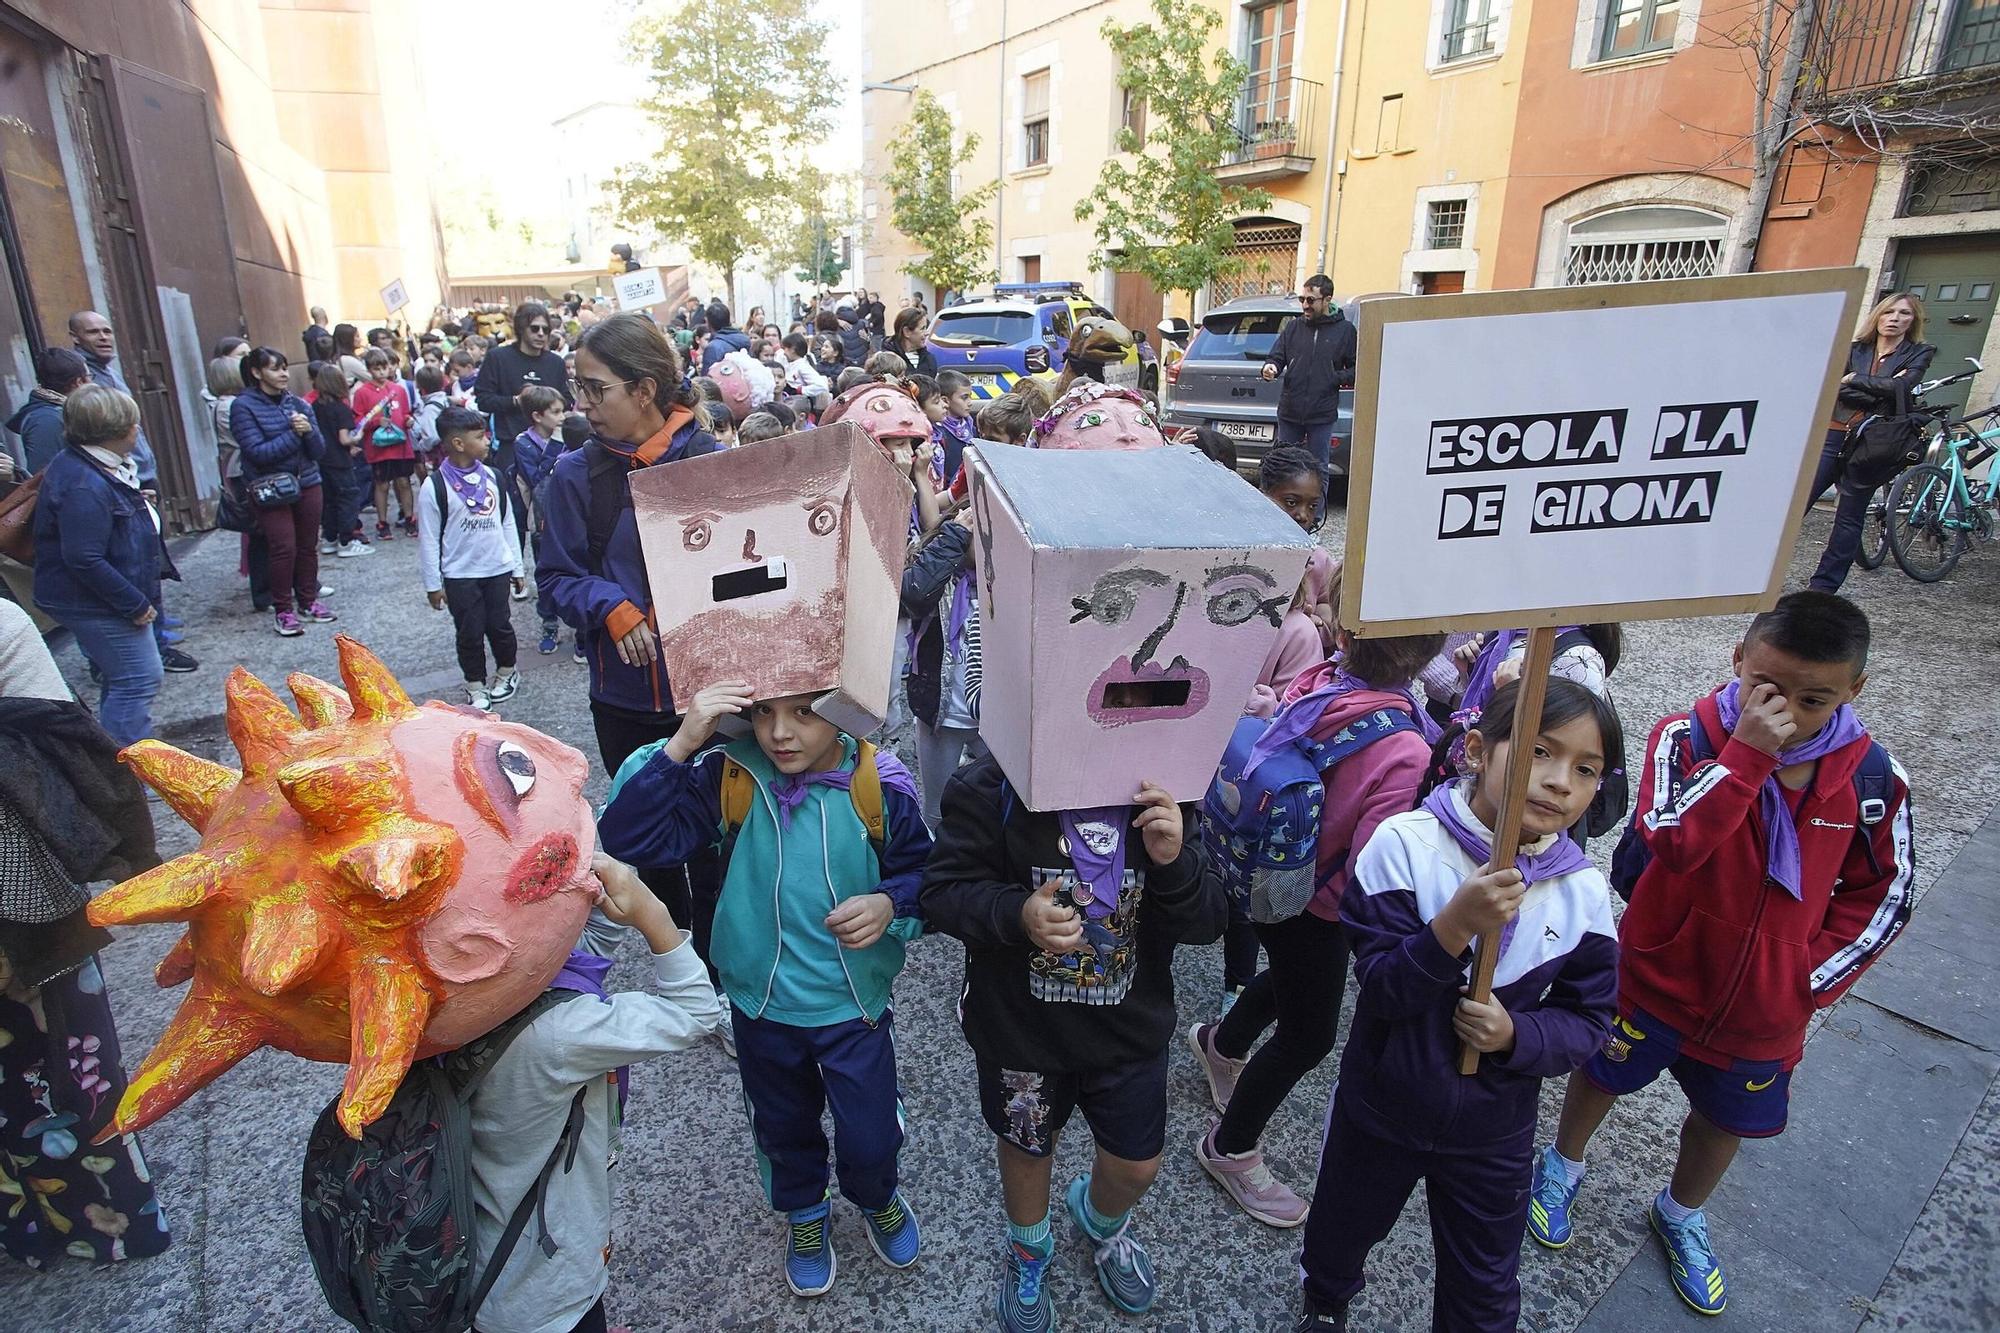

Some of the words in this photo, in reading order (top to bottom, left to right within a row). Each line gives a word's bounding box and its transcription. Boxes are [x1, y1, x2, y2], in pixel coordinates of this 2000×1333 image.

[1220, 423, 1245, 436] 7386
[1248, 424, 1267, 438] MFL
[1428, 412, 1623, 471] ESCOLA
[1652, 405, 1750, 456] PLA
[1441, 489, 1505, 534] DE
[1532, 476, 1712, 527] GIRONA
[1679, 777, 1714, 809] Champion
[1811, 818, 1854, 830] Champion
[1031, 866, 1146, 892] ITAA
